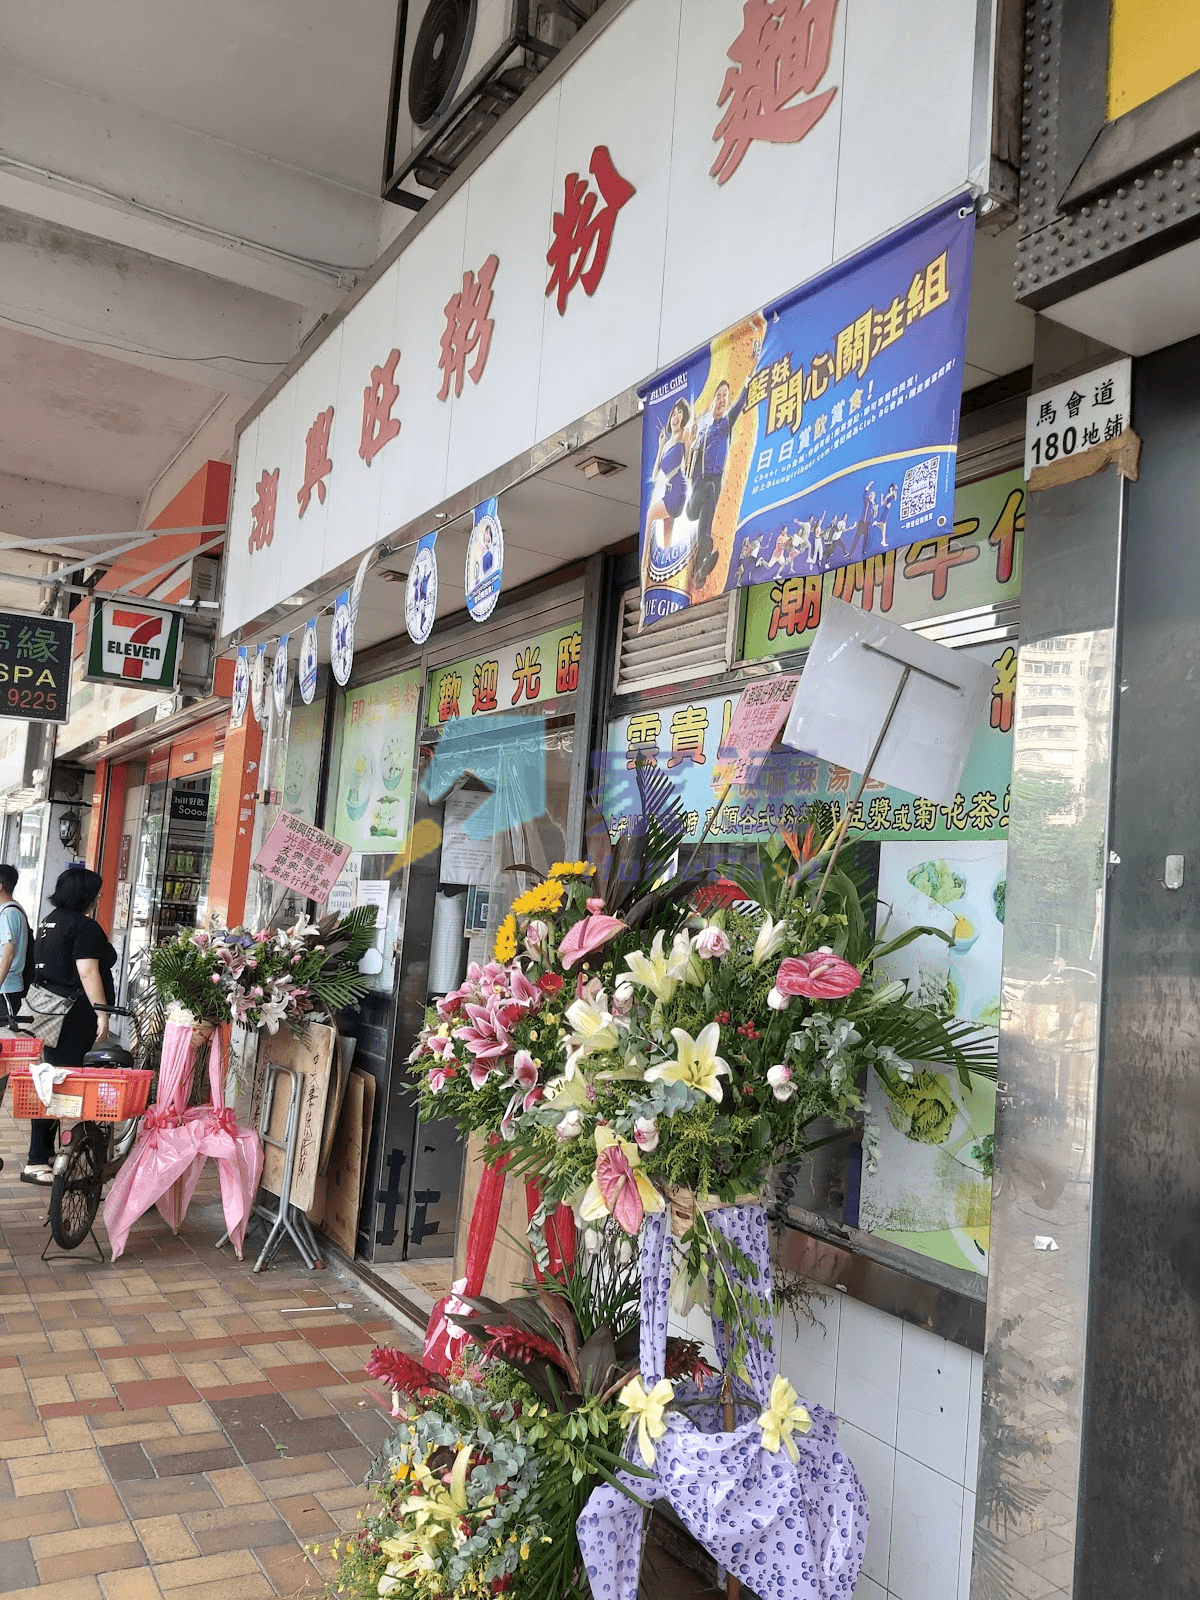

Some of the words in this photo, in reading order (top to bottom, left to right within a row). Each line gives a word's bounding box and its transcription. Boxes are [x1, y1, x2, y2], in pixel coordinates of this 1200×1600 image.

[766, 249, 950, 436] 開心關注組
[650, 382, 670, 401] BLUE
[670, 371, 688, 390] GIRL
[744, 356, 792, 412] 藍妹
[1036, 379, 1116, 427] 馬會道
[657, 599, 684, 617] GIR
[112, 609, 163, 679] 7
[0, 663, 57, 688] SPA
[7, 688, 57, 711] 9225
[438, 631, 582, 723] 歡迎光臨
